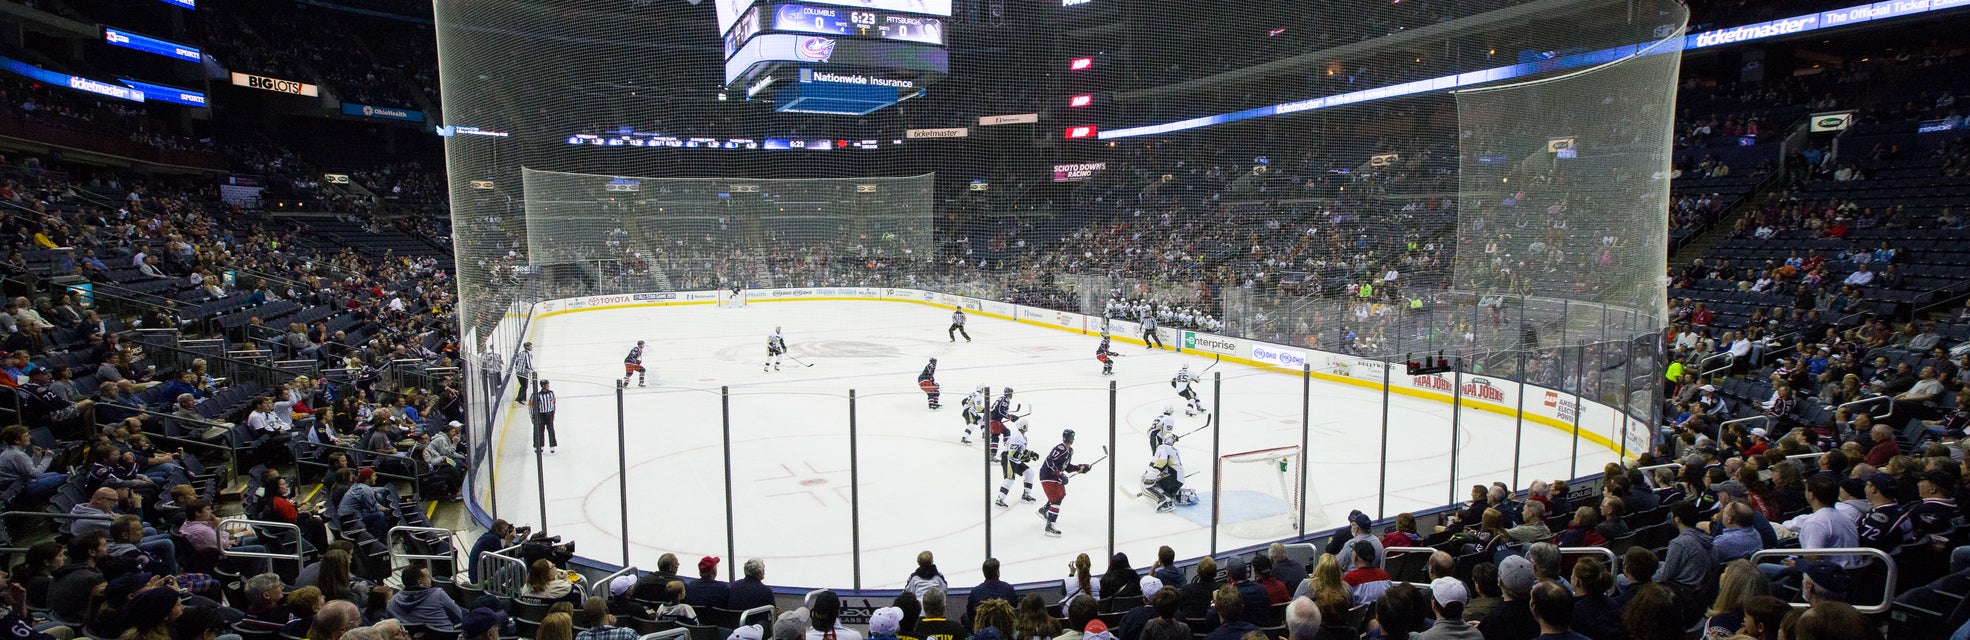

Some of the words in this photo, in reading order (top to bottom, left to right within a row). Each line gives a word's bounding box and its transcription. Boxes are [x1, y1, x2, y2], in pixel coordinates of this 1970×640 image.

[803, 7, 836, 17] COLUMBUS
[851, 11, 875, 24] 6:23
[1827, 12, 1847, 24] The
[1850, 4, 1890, 20] Official
[815, 16, 823, 29] 0
[886, 16, 921, 25] PITTSBURGH
[861, 27, 866, 35] 1
[899, 25, 907, 37] 0
[1696, 16, 1809, 48] ticketmaster
[1072, 58, 1090, 69] AEP
[813, 72, 868, 84] Nationwide
[870, 75, 913, 88] Insurance
[70, 76, 128, 98] ticketmaster
[1071, 96, 1090, 107] AEP
[374, 109, 407, 118] OhioHealth
[1071, 127, 1090, 137] AEP
[1053, 164, 1079, 172] SCIOTO
[600, 295, 631, 304] TOYOTA
[1187, 336, 1236, 351] enterprise
[1413, 376, 1431, 389] PAPA
[42, 391, 56, 401] 72
[1558, 399, 1587, 412] AMERIAN
[1557, 406, 1583, 418] ELECTRC
[1567, 487, 1592, 500] LEXUS
[1861, 525, 1881, 540] 72
